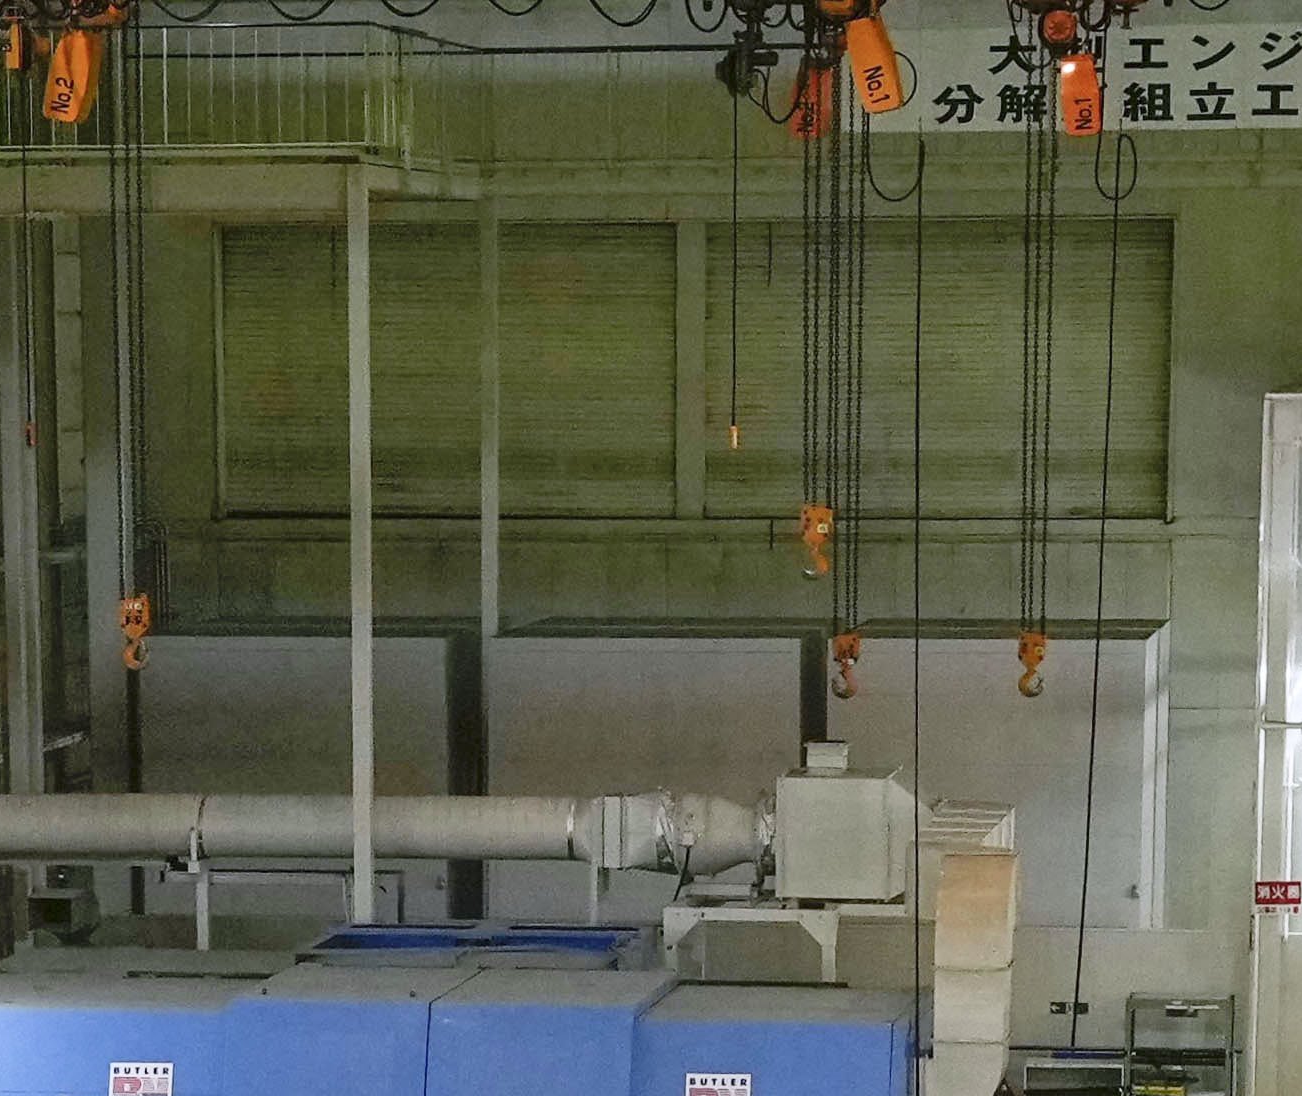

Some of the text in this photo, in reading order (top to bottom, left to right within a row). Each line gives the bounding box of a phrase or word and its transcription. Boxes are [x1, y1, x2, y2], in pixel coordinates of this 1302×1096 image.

[50, 77, 74, 114] No.2
[863, 65, 891, 104] No.1
[1074, 98, 1092, 130] No.1
[113, 1067, 169, 1075] BUTLER
[689, 1078, 747, 1086] BUTLER
